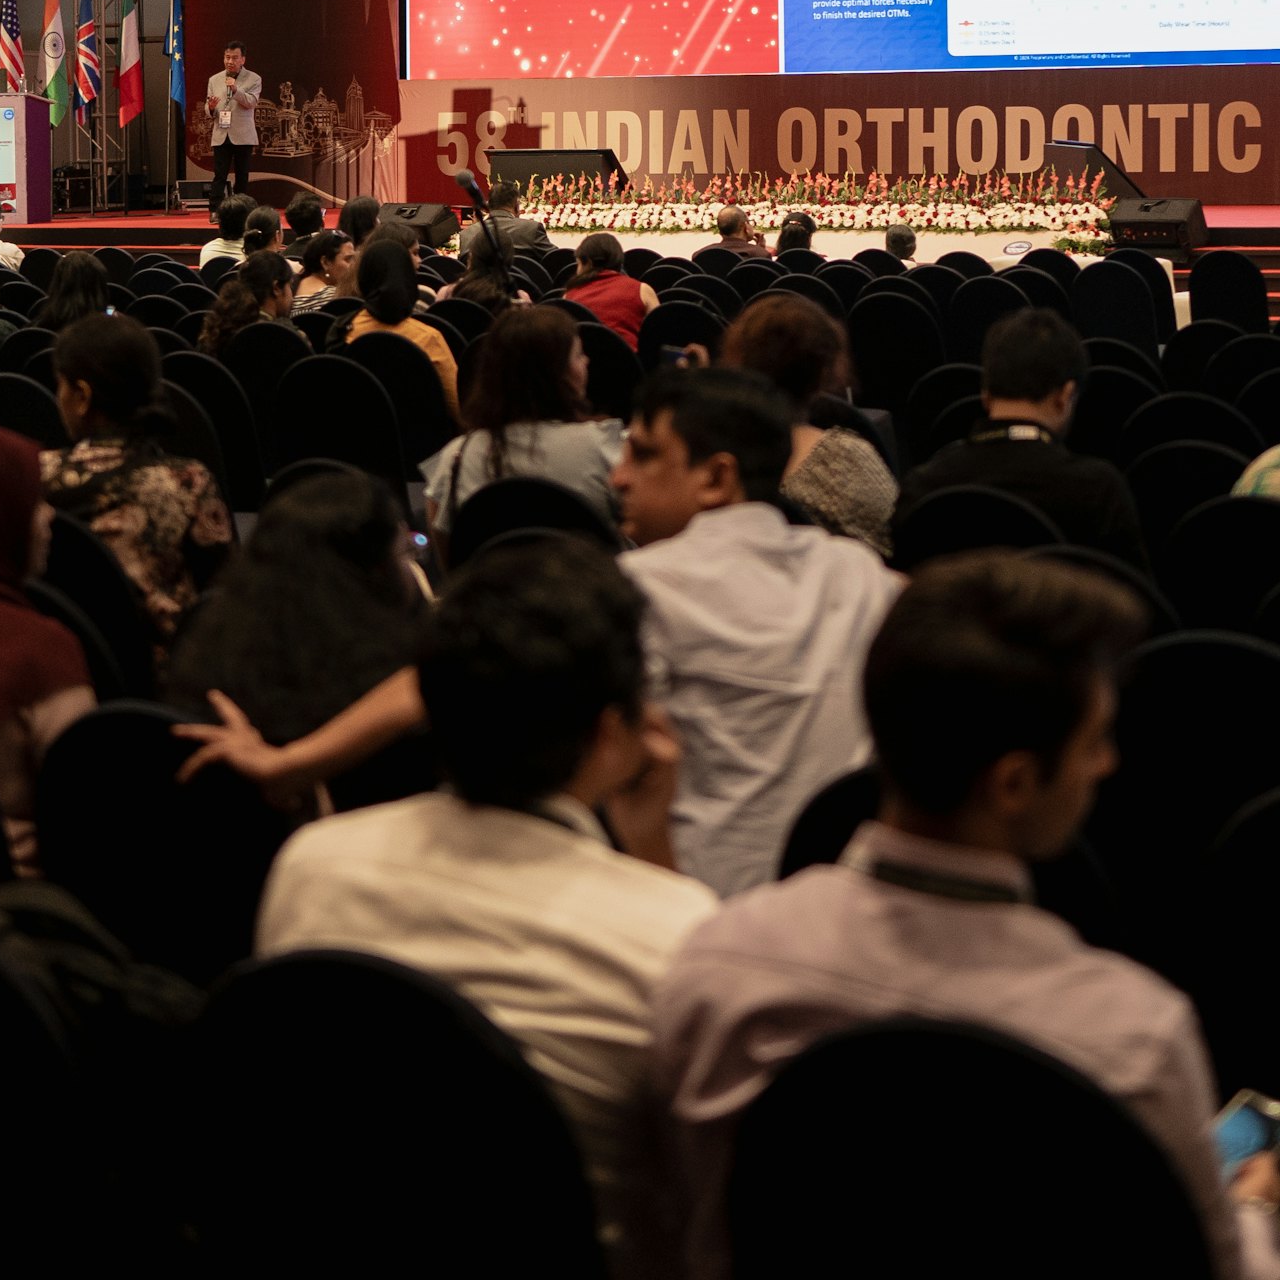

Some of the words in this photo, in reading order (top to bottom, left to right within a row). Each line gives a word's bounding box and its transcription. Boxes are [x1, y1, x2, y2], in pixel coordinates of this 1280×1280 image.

[813, 11, 822, 20] to
[822, 10, 843, 19] finish
[843, 10, 858, 19] the
[858, 9, 886, 19] desired
[886, 9, 911, 18] OTMs.
[540, 109, 750, 175] INDIAN
[776, 101, 1262, 175] ORTHODONTIC
